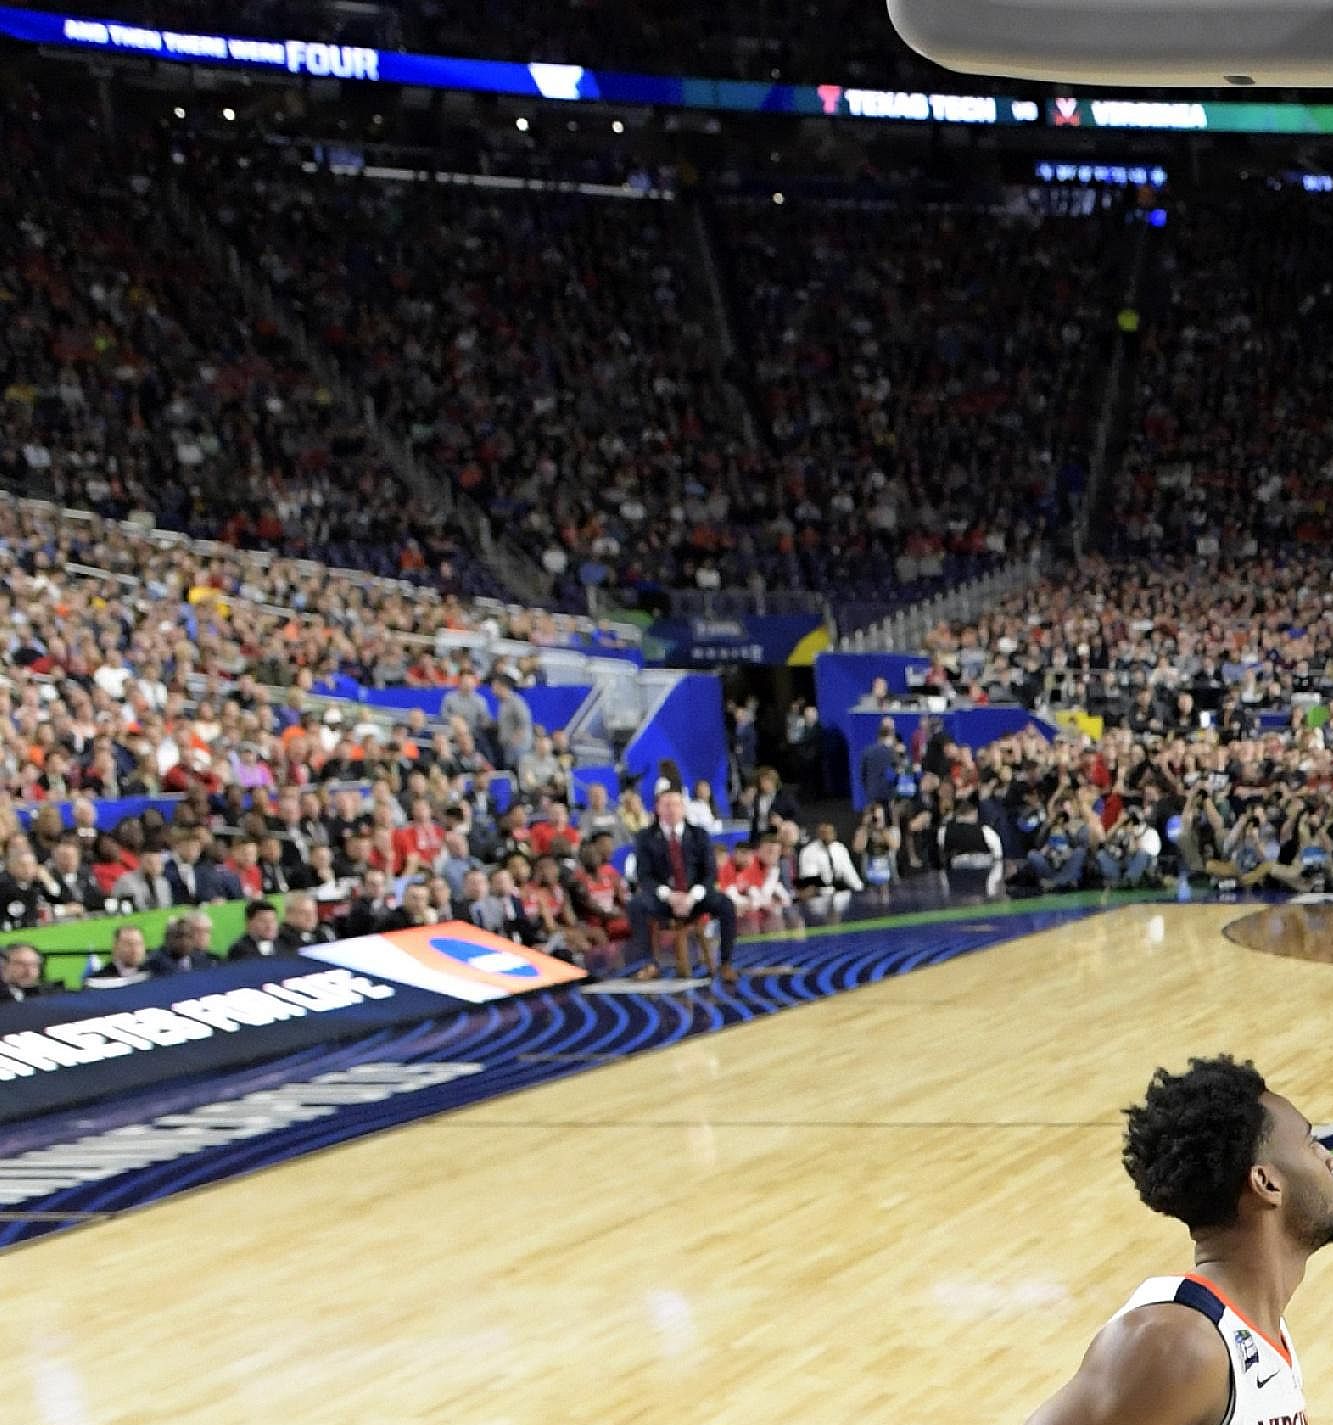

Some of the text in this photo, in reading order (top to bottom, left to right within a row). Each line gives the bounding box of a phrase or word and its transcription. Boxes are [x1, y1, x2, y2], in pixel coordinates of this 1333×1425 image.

[285, 40, 379, 81] FOUR
[844, 89, 997, 123] TEXAS TECH
[1091, 100, 1208, 129] VIRGINIA
